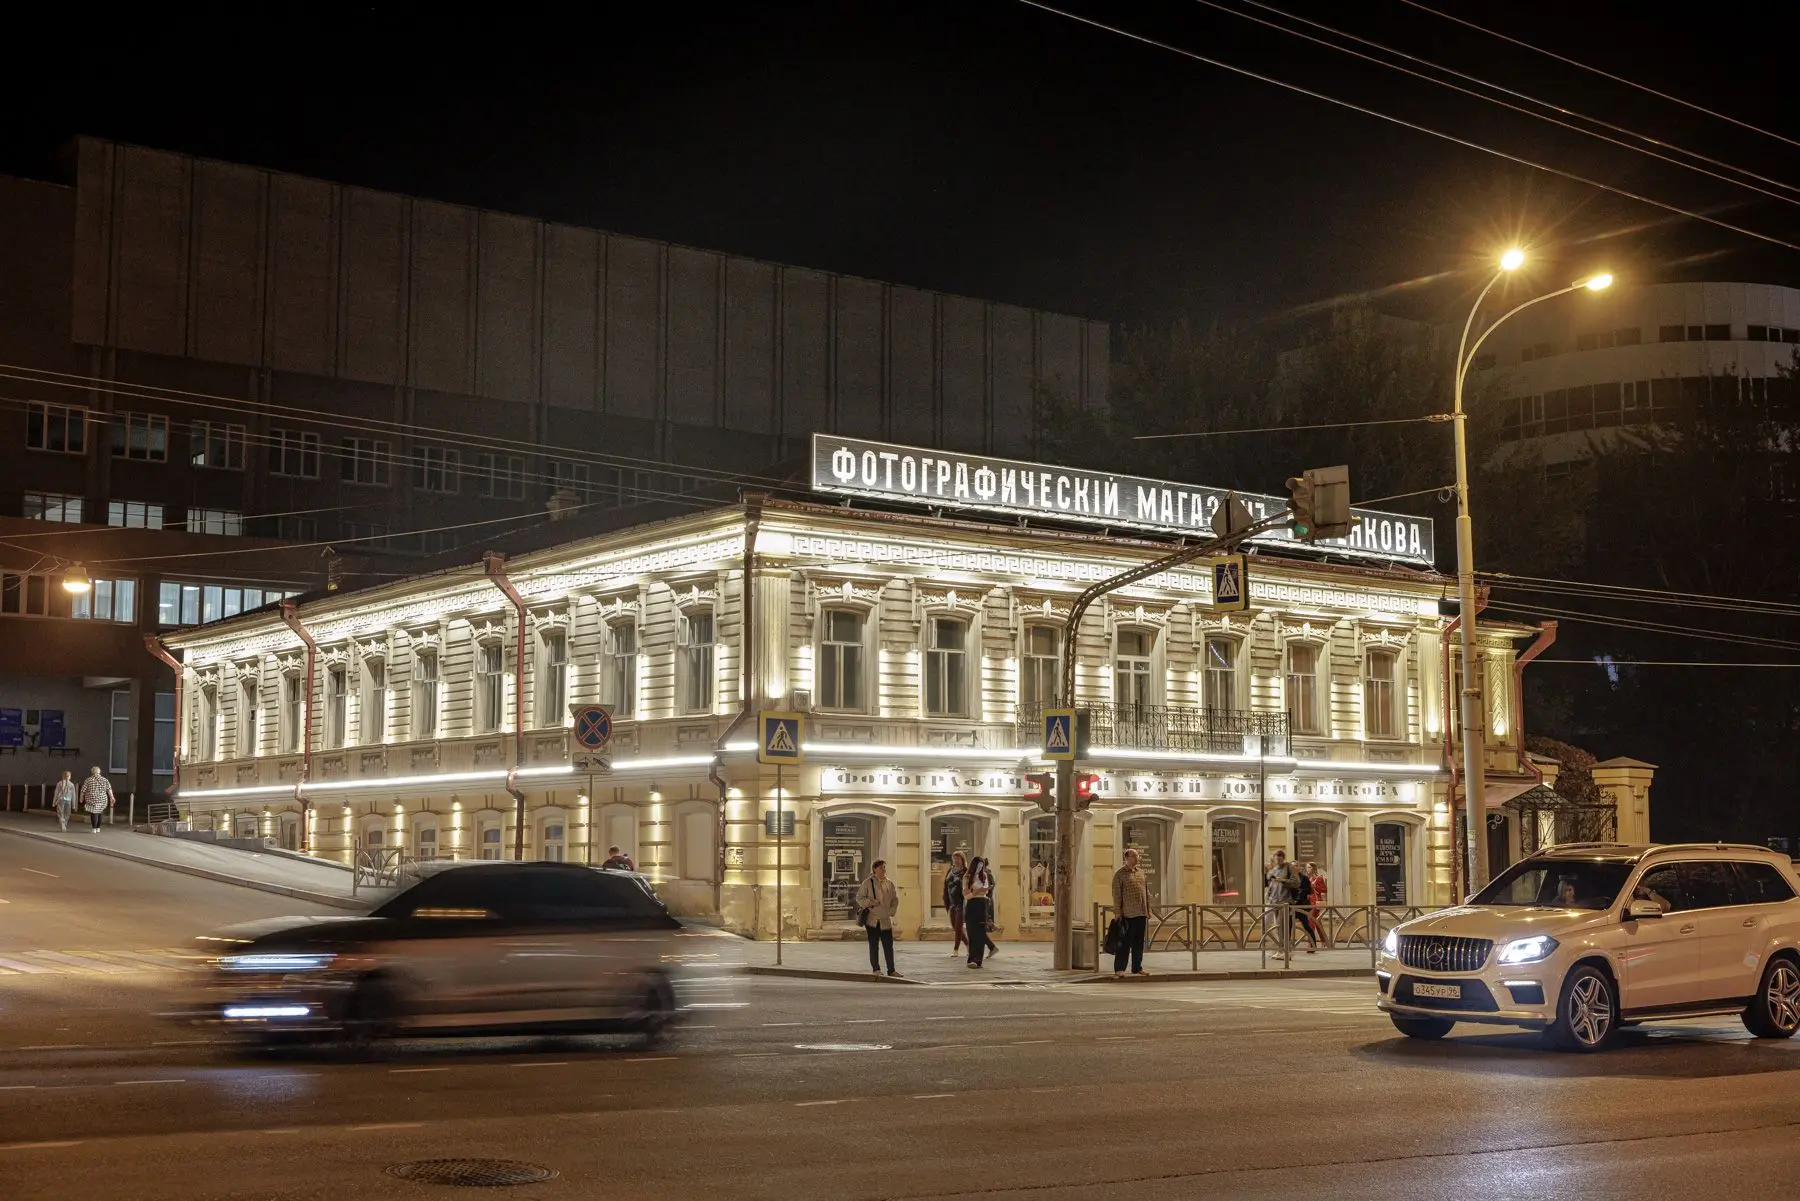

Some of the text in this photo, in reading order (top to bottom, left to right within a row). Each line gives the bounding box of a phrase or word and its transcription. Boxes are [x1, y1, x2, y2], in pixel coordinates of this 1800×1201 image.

[832, 446, 1119, 516] ФОТОГРАФИЧЕСКІЙ
[1123, 780, 1201, 793] МУЗЕЙ
[1221, 782, 1260, 798] ДОМ
